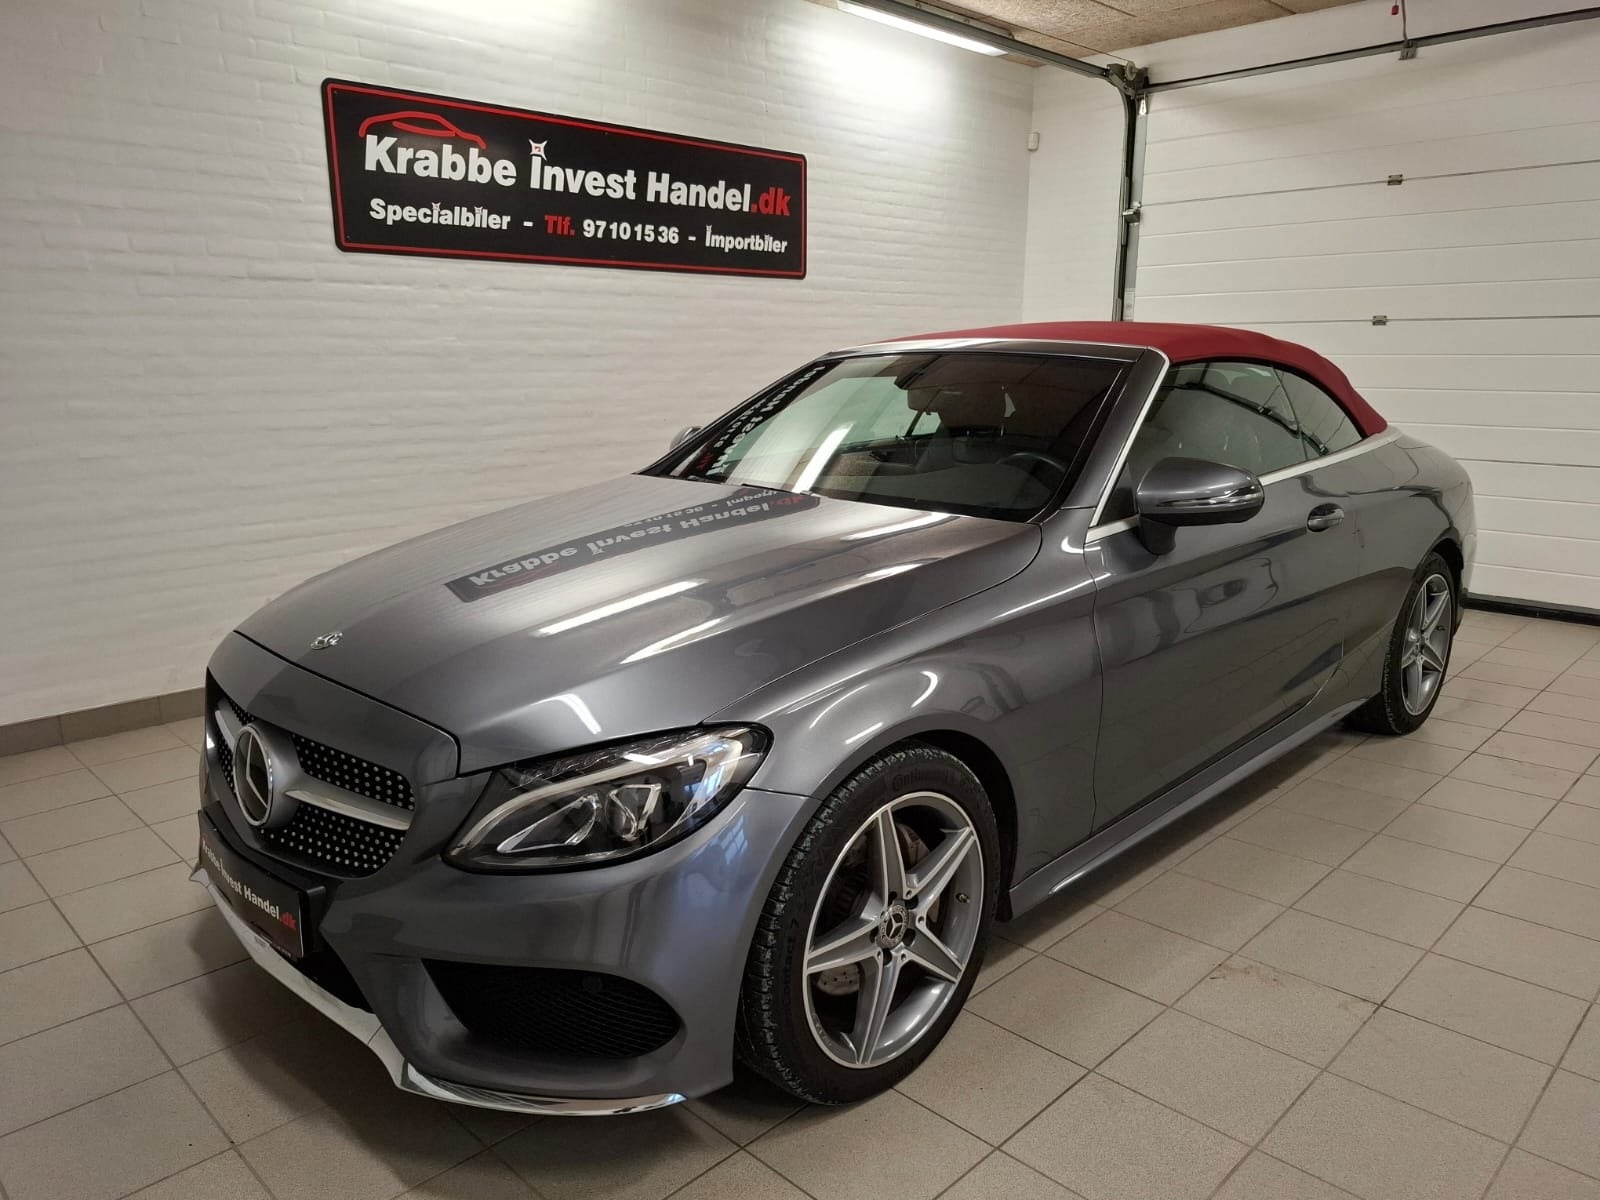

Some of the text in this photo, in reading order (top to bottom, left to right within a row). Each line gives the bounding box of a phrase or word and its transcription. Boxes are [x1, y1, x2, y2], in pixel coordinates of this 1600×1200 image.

[365, 134, 791, 216] Krabbe Invest Handel.dk
[369, 198, 511, 230] Specialbiler
[544, 215, 576, 236] Tlf.
[705, 225, 788, 253] Importbiler
[244, 885, 296, 930] Handel.dk
